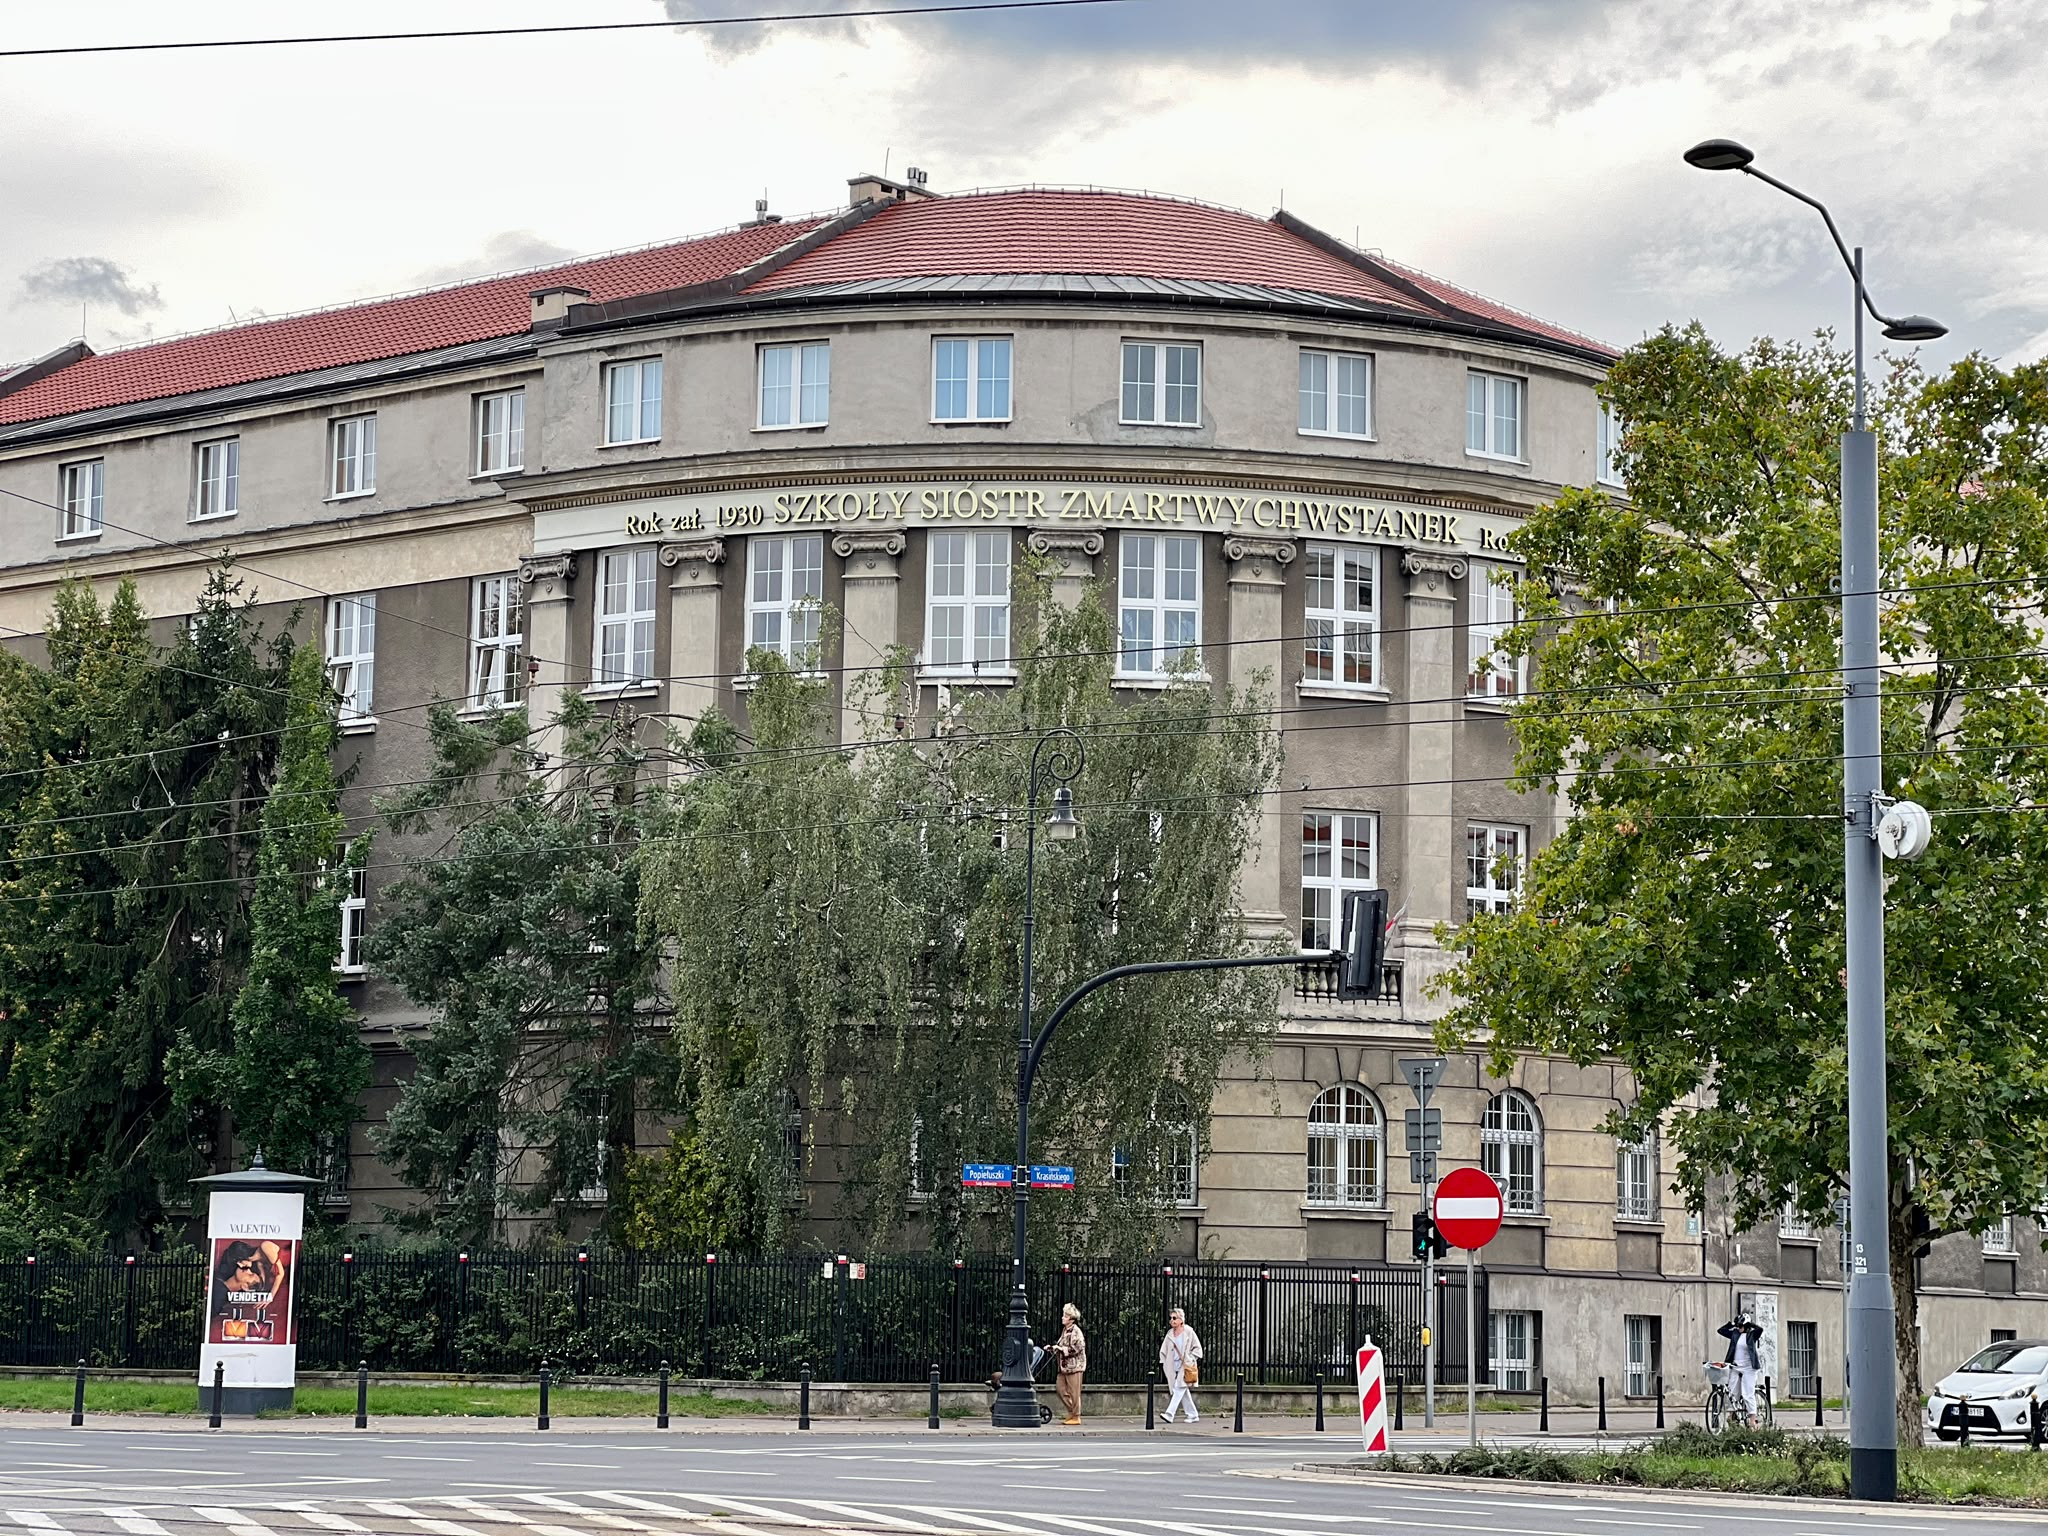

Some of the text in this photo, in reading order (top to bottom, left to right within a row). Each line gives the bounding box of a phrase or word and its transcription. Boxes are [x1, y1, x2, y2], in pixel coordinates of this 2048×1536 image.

[624, 513, 662, 536] Rok
[670, 508, 705, 532] zał.
[716, 503, 763, 528] 1930
[774, 491, 911, 524] SZKOŁY
[920, 481, 1049, 521] SIÓSTR
[1058, 489, 1462, 545] ZMARTWYCHWSTANEK
[969, 1169, 1005, 1181] Popiełuszki
[1036, 1171, 1070, 1183] Krasińskiego
[229, 1223, 281, 1235] VALENTINO
[227, 1291, 273, 1302] VENDETTA
